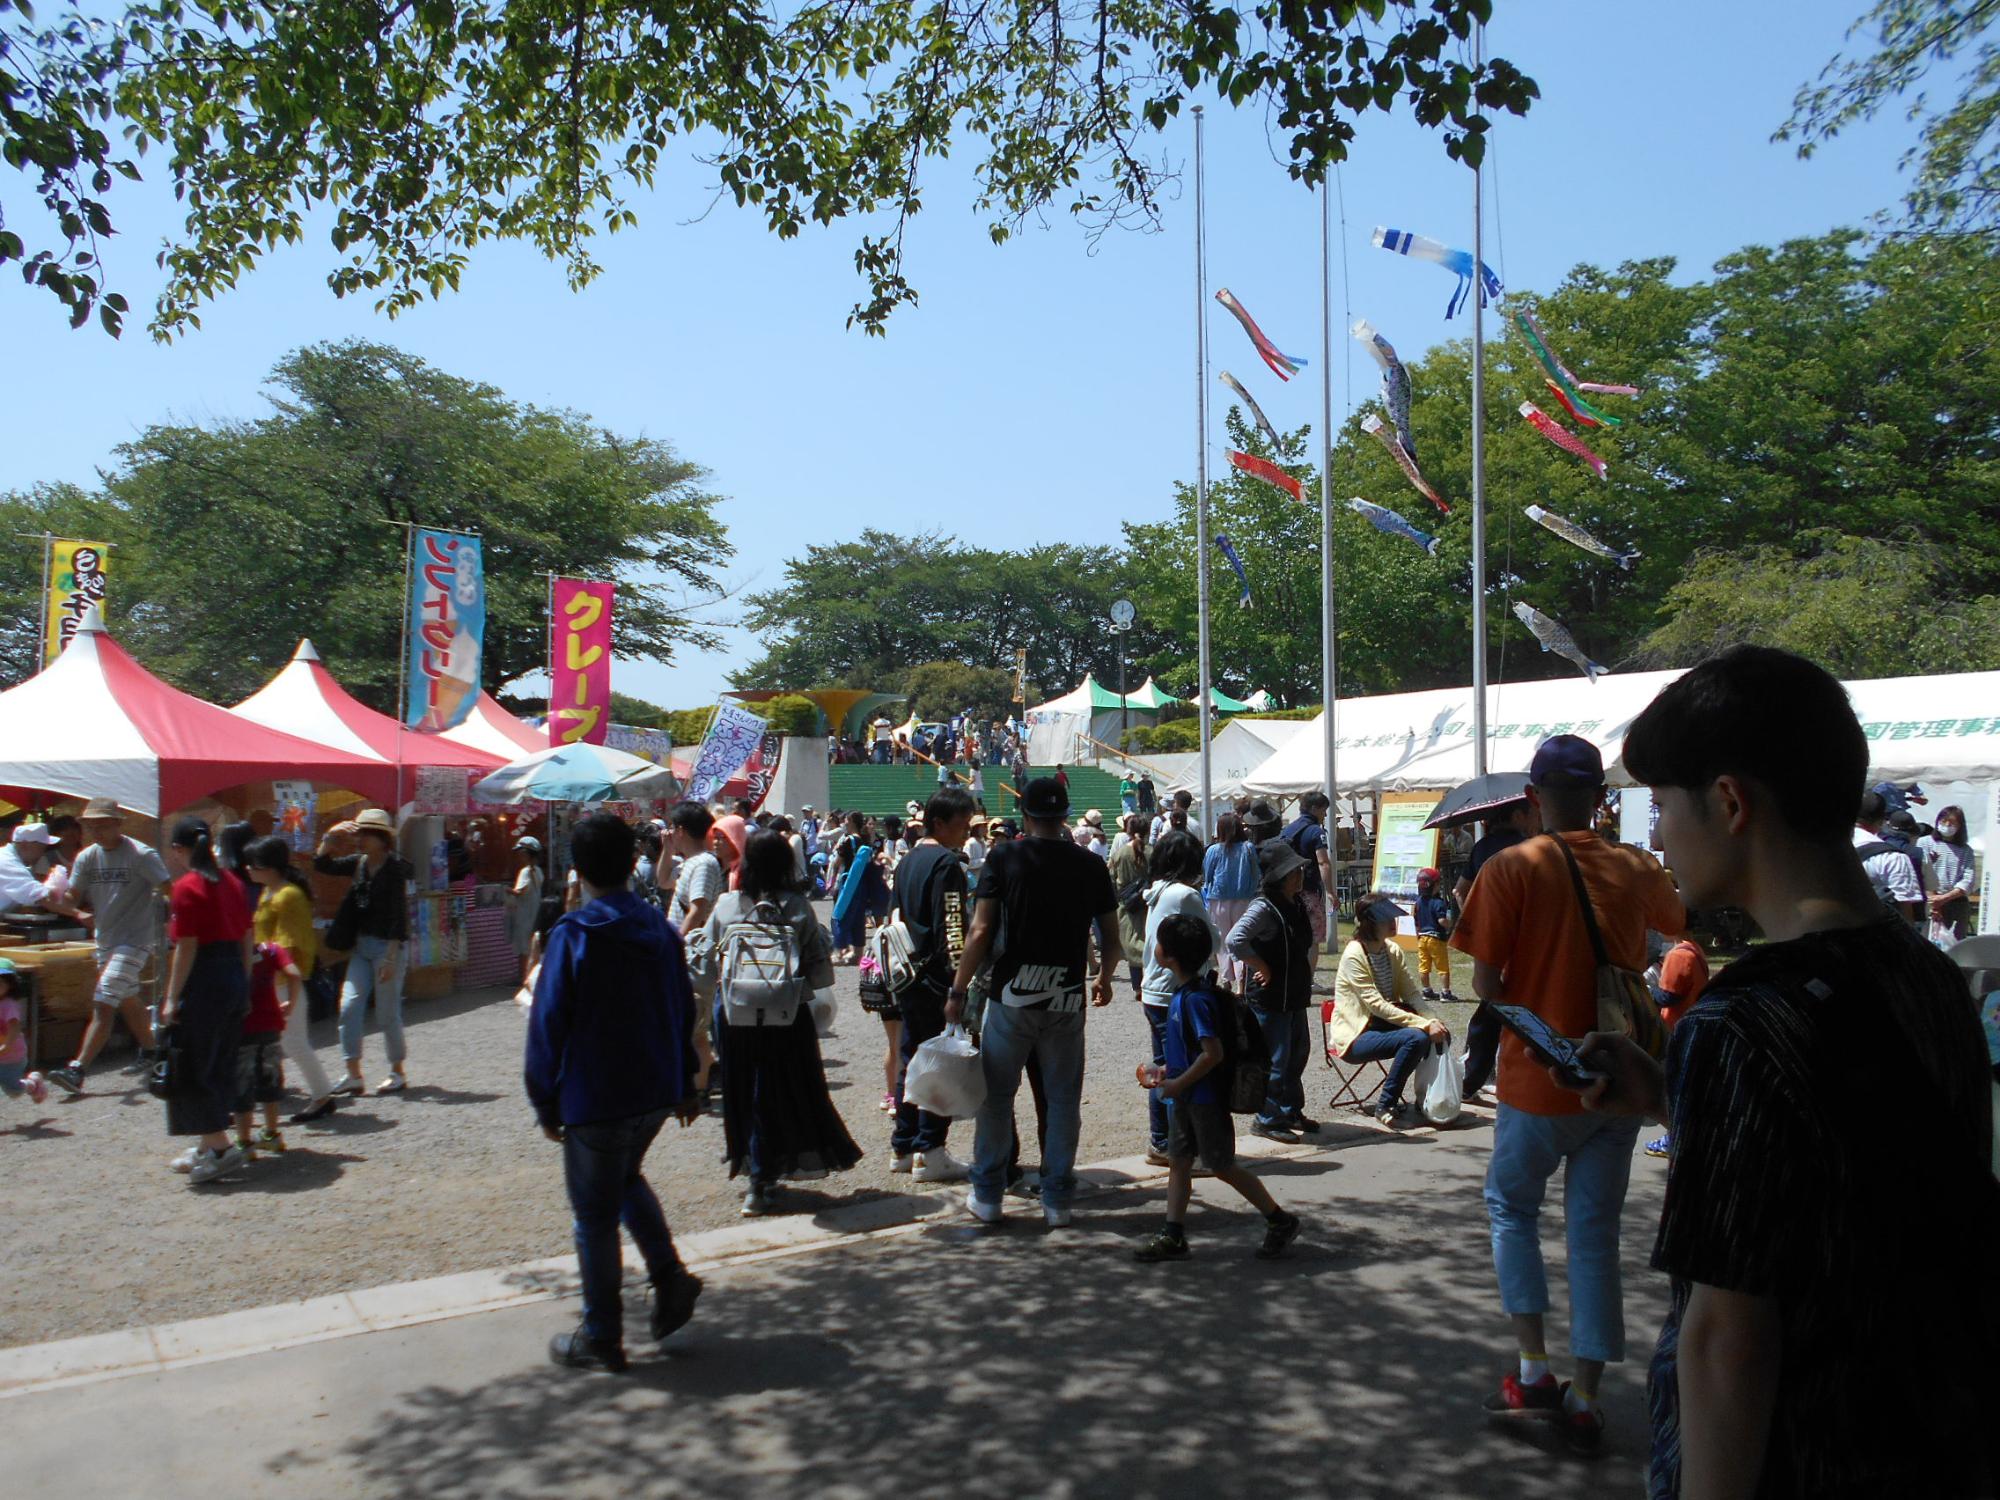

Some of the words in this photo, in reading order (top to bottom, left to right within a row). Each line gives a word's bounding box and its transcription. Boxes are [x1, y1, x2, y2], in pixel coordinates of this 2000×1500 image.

[559, 591, 602, 742] クレープ
[1012, 964, 1069, 992] NIKE
